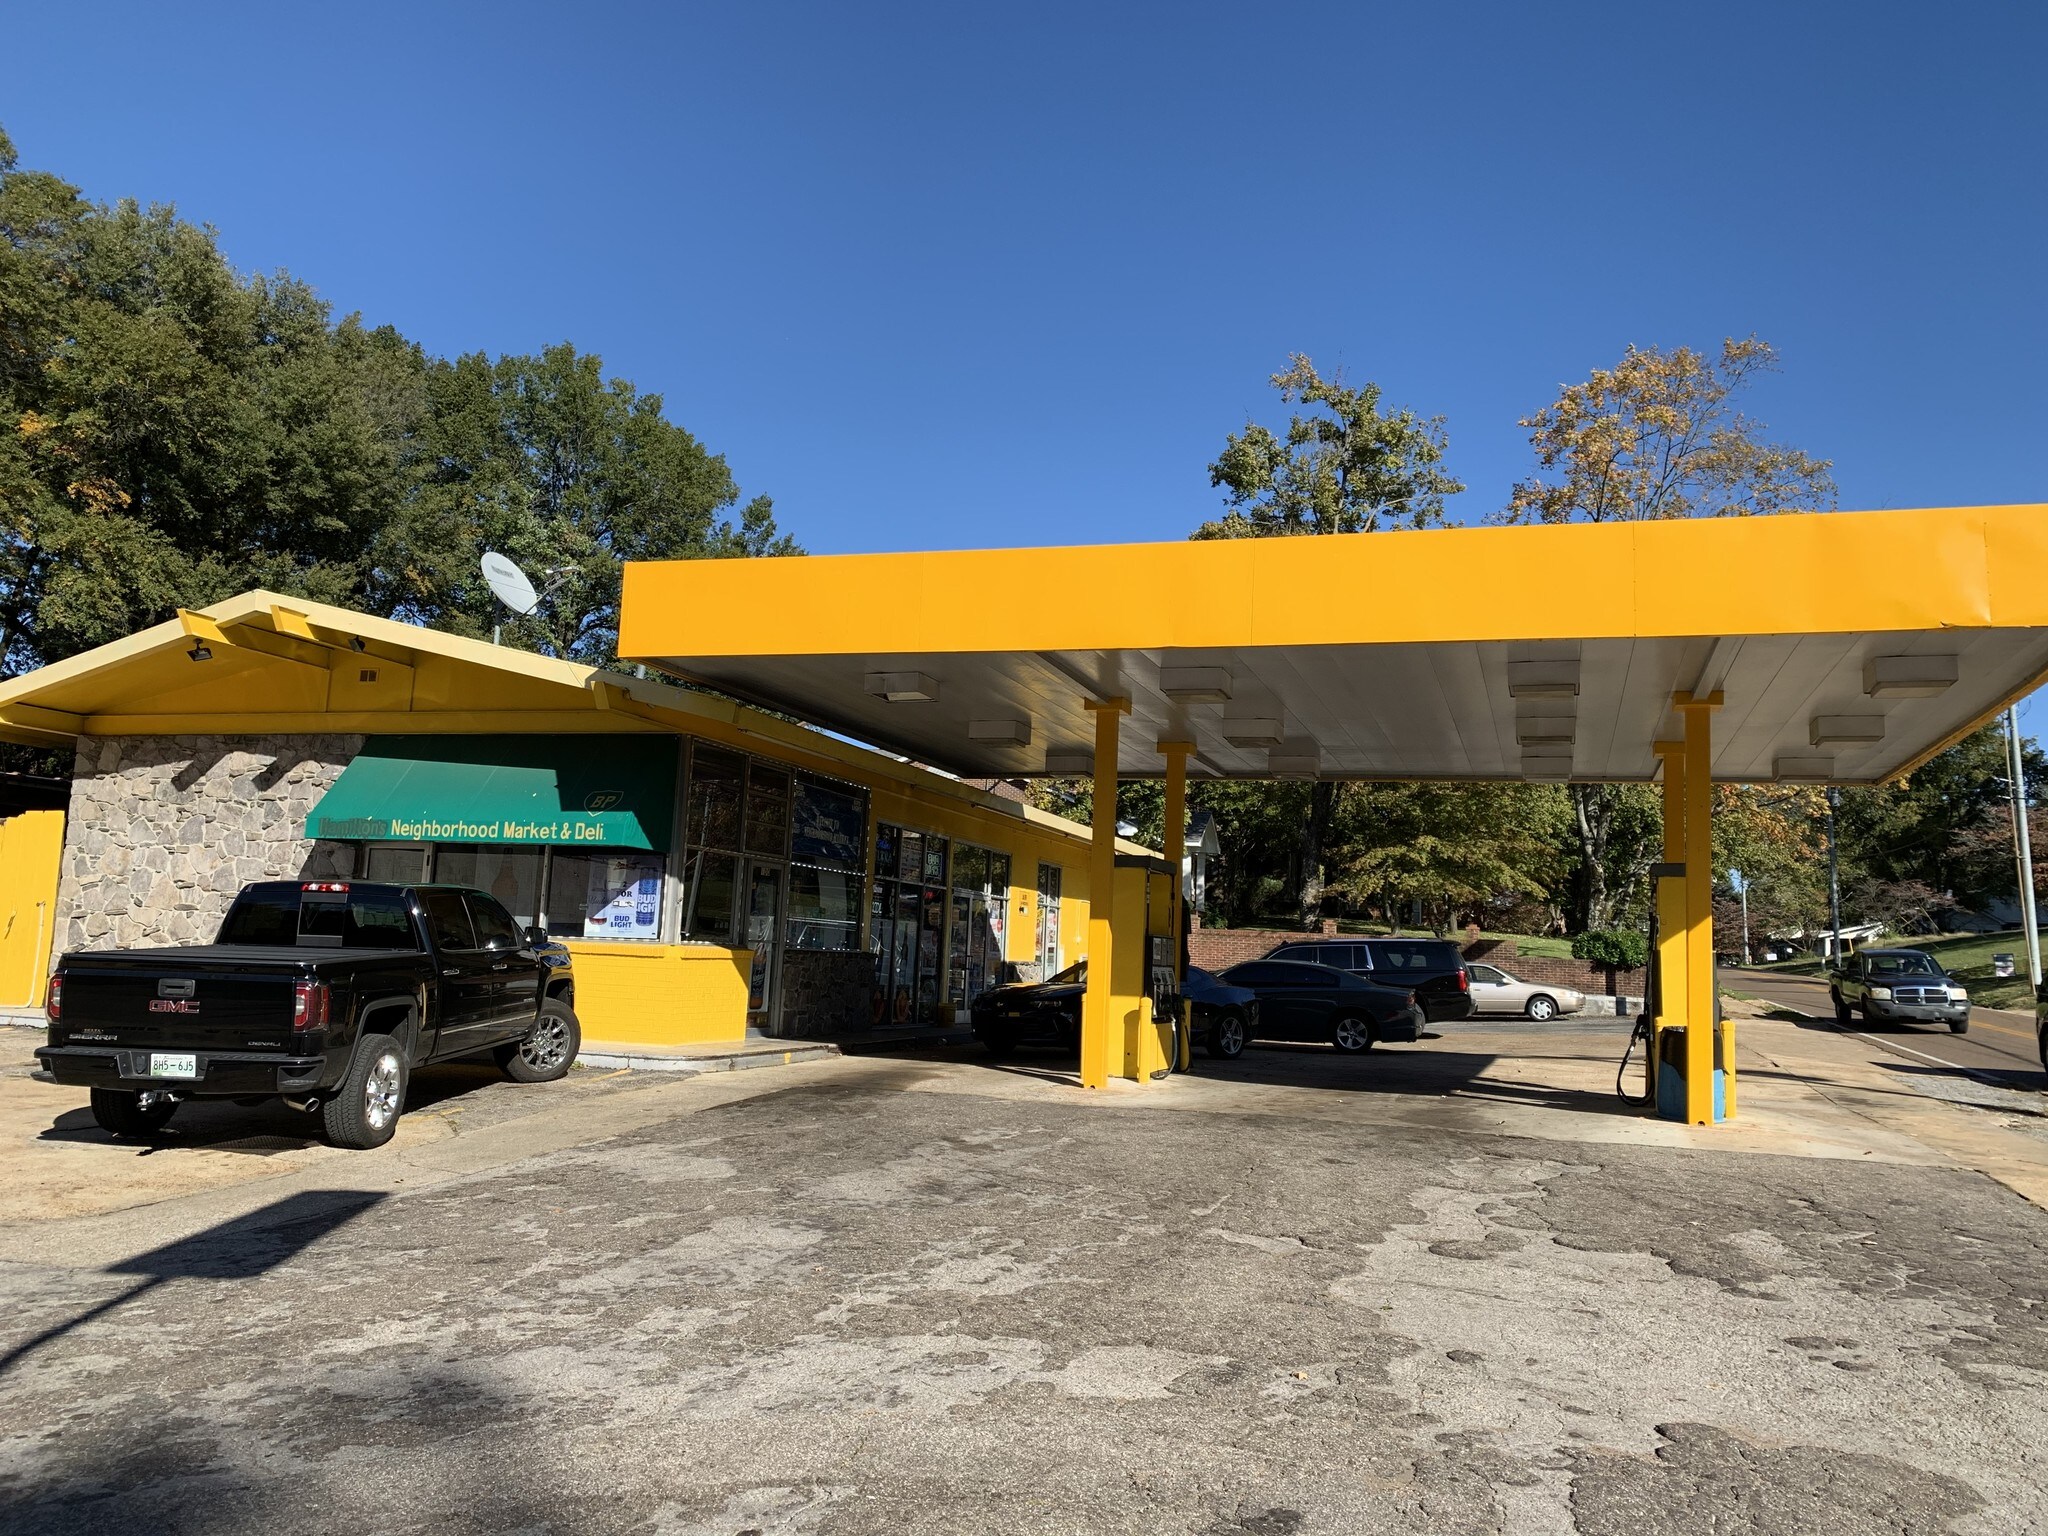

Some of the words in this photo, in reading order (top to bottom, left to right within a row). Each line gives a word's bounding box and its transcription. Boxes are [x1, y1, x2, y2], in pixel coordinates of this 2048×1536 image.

[589, 795, 617, 808] BP
[391, 820, 499, 840] Neighborhood
[503, 822, 558, 840] Market
[560, 823, 572, 839] &
[637, 894, 656, 904] BUD
[636, 903, 655, 913] IGH
[149, 999, 200, 1014] GMC
[68, 1033, 118, 1041] SIERRA
